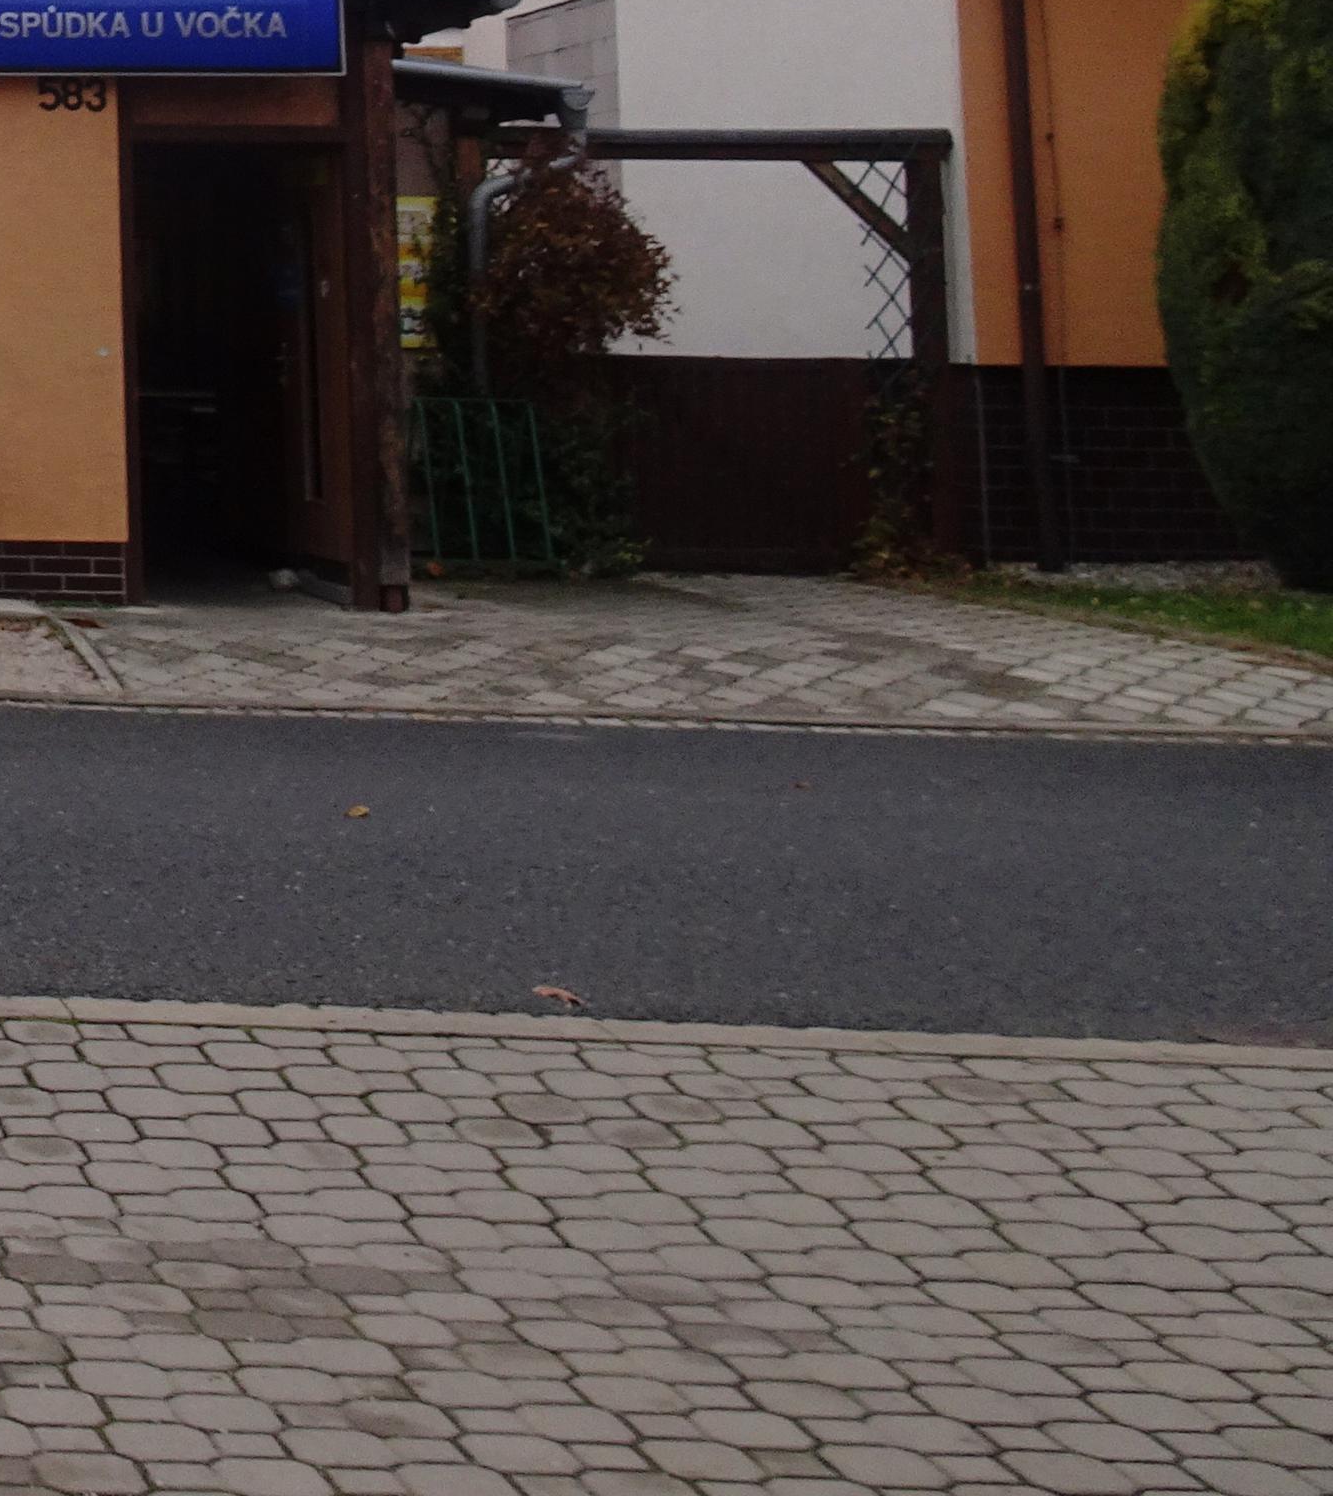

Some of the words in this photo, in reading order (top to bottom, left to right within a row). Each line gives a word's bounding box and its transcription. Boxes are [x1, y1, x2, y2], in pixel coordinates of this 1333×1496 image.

[141, 11, 165, 38] U
[174, 5, 288, 39] VOČKA
[37, 77, 108, 112] 583
